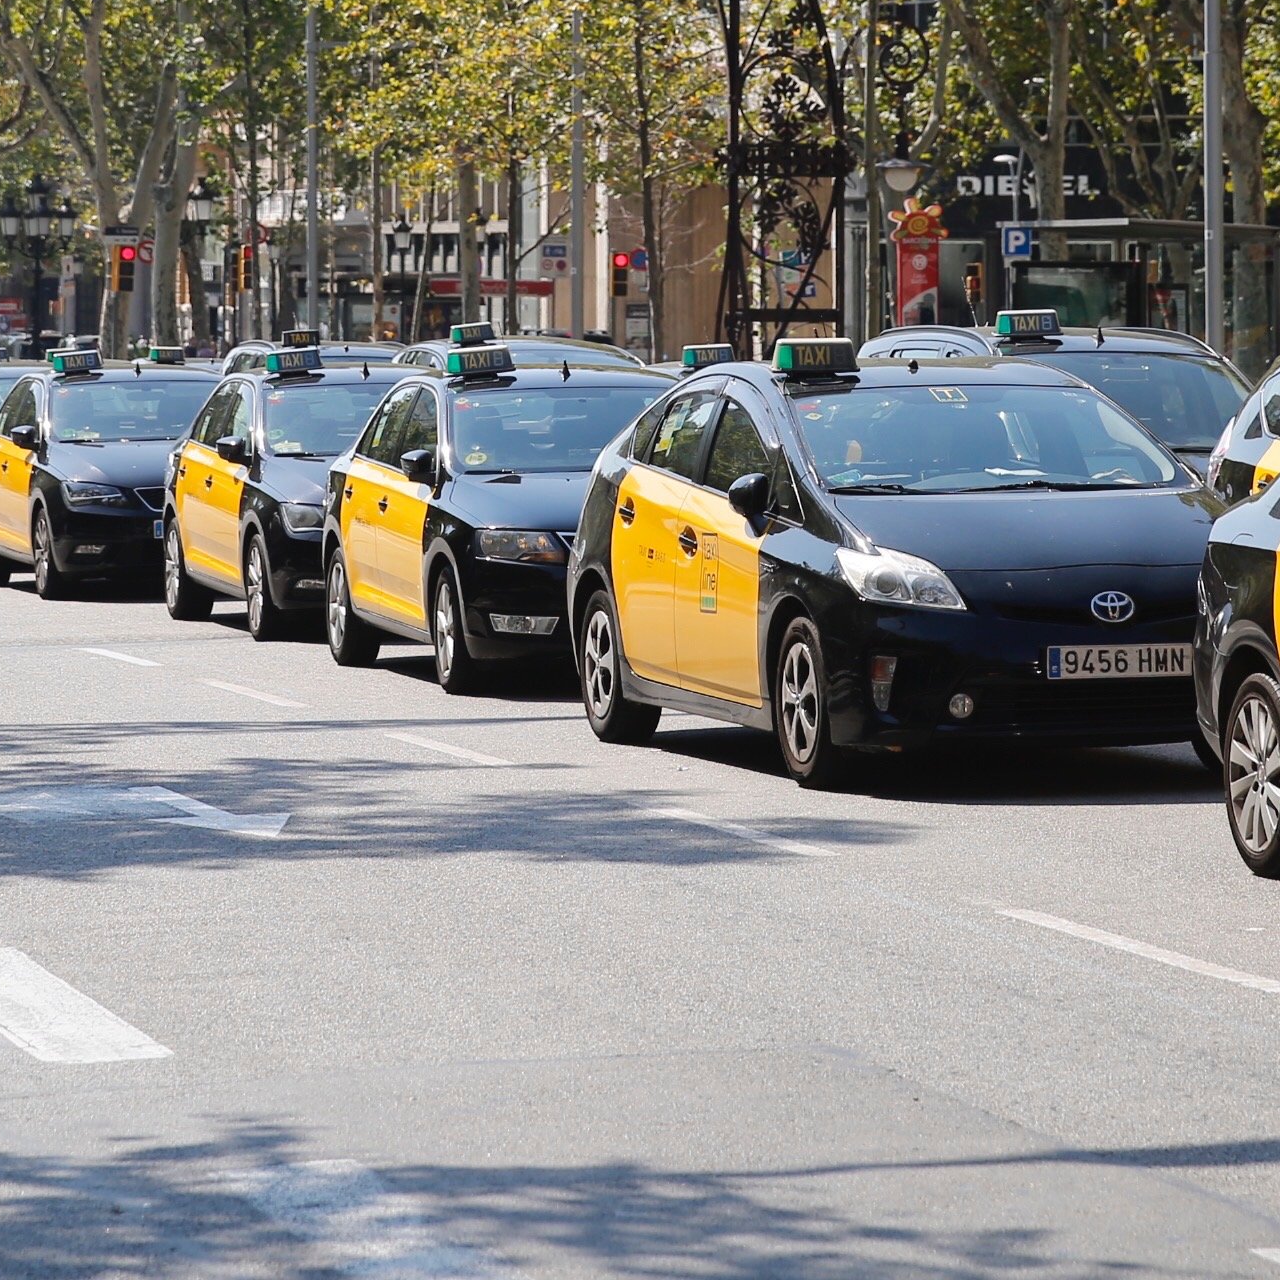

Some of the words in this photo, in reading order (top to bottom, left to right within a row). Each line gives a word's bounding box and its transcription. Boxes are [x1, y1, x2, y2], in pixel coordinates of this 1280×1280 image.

[1008, 230, 1026, 253] P
[462, 326, 482, 339] TAXI
[1013, 317, 1040, 332] TAXI
[290, 332, 310, 344] TAXI
[64, 356, 86, 369] TAXI
[281, 352, 304, 369] TAXI
[465, 352, 491, 370] TAXI
[696, 348, 718, 363] TAXI
[795, 345, 832, 367] TAXI
[1064, 649, 1129, 675] 9456
[1137, 647, 1185, 674] HMN
